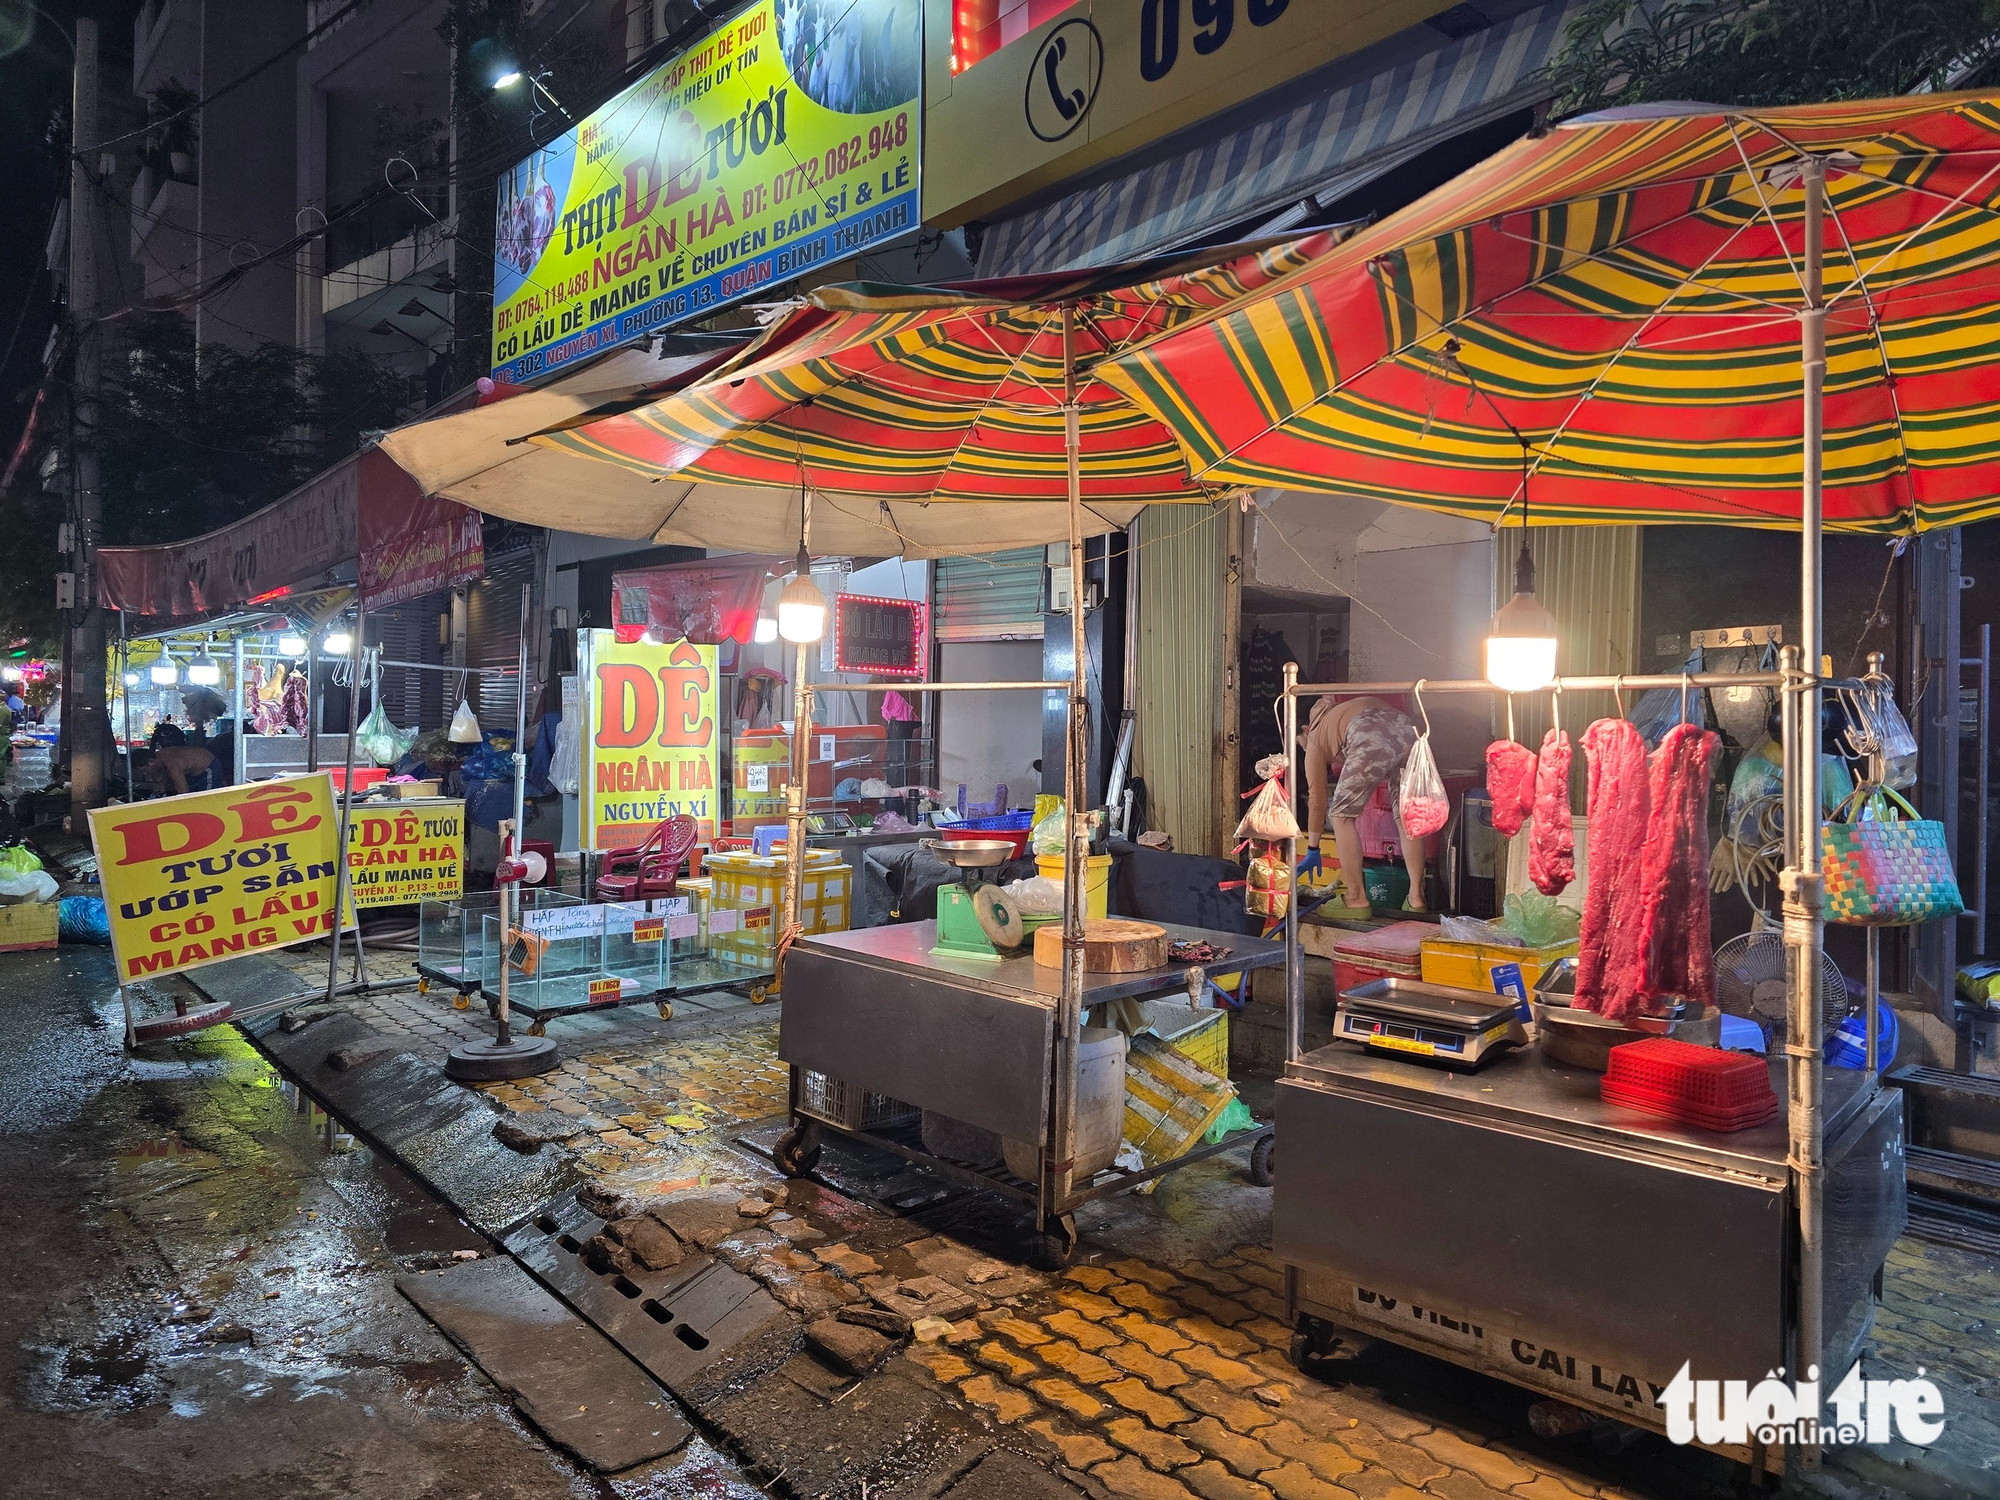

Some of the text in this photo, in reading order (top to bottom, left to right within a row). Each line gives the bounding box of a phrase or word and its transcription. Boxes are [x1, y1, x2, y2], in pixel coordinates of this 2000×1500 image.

[1140, 0, 1290, 82] 09
[582, 122, 598, 147] ĐỊA
[689, 46, 715, 79] THỊT
[717, 30, 734, 61] DÊ
[737, 10, 767, 47] TƯƠI
[586, 135, 614, 166] HÀNG
[684, 74, 712, 105] HIỆU
[716, 60, 733, 85] UY
[736, 44, 759, 72] TÍN
[562, 85, 787, 255] THỊT DÊ TƯƠI
[498, 112, 908, 333] ĐT: 0764.119.488 NGÂN HÀ ĐT: 0772.082.948
[496, 156, 910, 362] CÓ LẨU DÊ MANG VỀ CHUYÊN BÁN SỈ & LẺ
[517, 352, 543, 379] 302
[546, 329, 598, 367] NGUYỄN
[600, 319, 619, 345] XÍ,
[623, 293, 686, 336] PHƯỜNG
[691, 284, 716, 308] 13,
[721, 259, 772, 297] QUẬN
[777, 236, 827, 276] BÌNH
[833, 202, 908, 252] THẠNH
[841, 606, 861, 638] CÓ
[865, 605, 893, 640] LẨU
[848, 646, 888, 665] MANG
[595, 636, 713, 748] DÊ
[597, 754, 713, 793] NGÂN HÀ
[111, 784, 322, 867] DÊ
[360, 809, 420, 848] DÊ
[423, 816, 459, 838] TƯƠI
[604, 793, 681, 821] NGUYỄN
[689, 795, 707, 817] XÍ
[161, 842, 293, 884] TƯƠI
[347, 844, 457, 868] GÂN HÀ
[350, 862, 456, 886] LẨU MANG VỀ
[119, 860, 336, 920] ƯỚP SẴN
[387, 885, 398, 894] XÍ
[407, 883, 428, 892] P.13
[437, 881, 459, 890] Q.BT
[150, 890, 320, 943] CÓ LẨU
[127, 926, 278, 977] MANG
